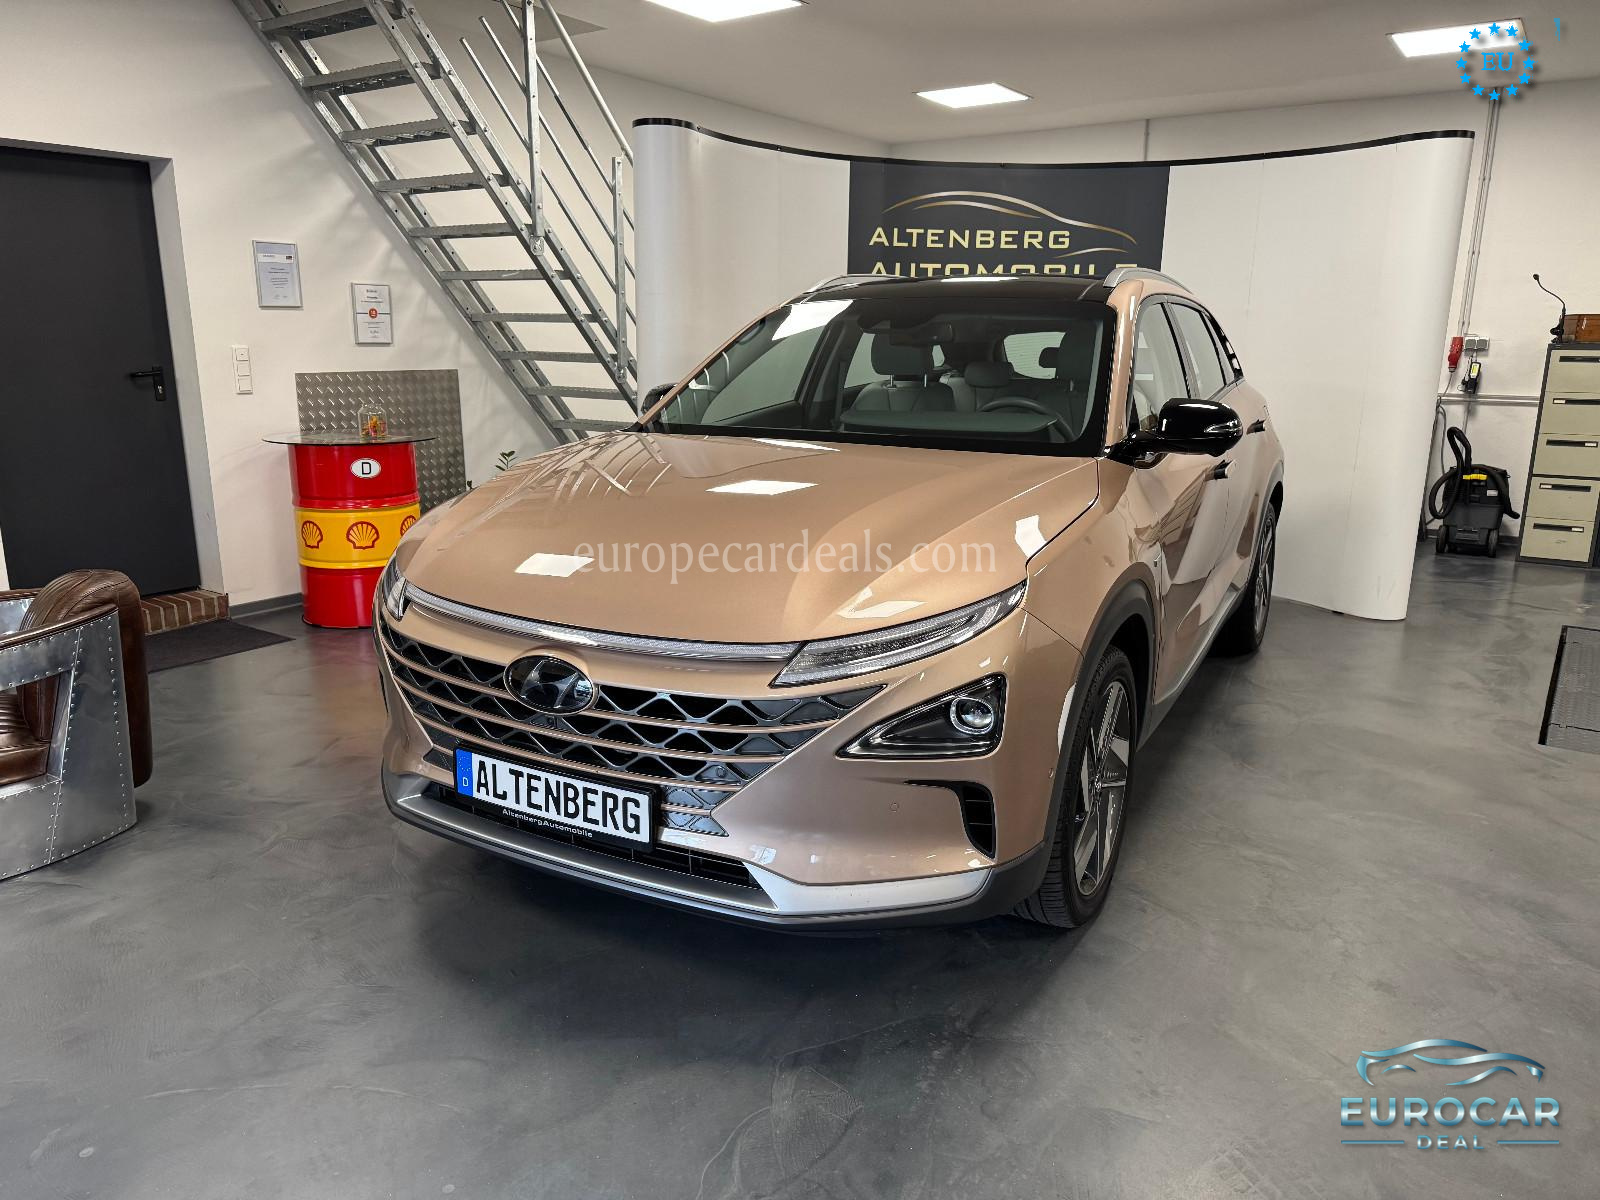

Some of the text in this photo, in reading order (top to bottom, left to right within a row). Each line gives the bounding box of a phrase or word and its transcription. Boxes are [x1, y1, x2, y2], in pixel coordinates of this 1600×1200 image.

[868, 226, 1071, 250] ALTENBERG
[871, 261, 1138, 277] AUTOMI
[361, 461, 372, 475] D
[462, 776, 469, 787] D
[476, 760, 641, 835] ALTENBERG
[502, 808, 593, 838] AltenbergAutomobile
